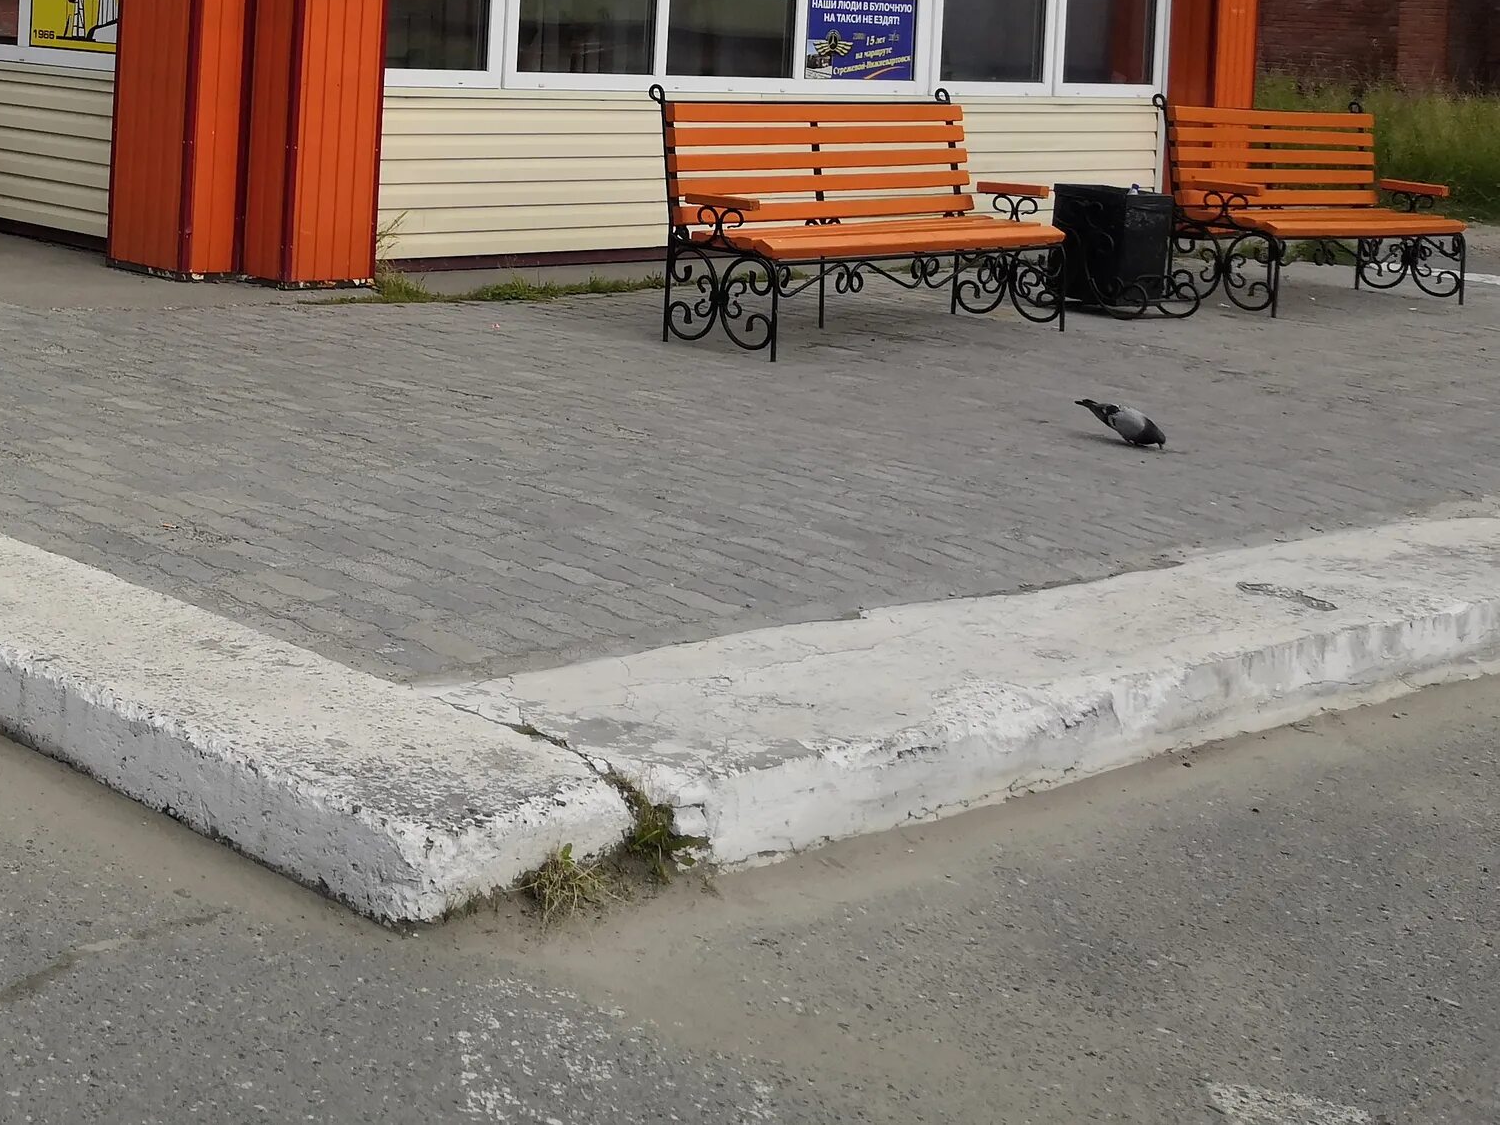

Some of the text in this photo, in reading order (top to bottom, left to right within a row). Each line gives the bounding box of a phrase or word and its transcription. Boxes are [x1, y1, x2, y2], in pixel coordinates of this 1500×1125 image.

[812, 0, 912, 13] НАШИ ЛЮДИ В БУЛОЧНУЮ
[824, 13, 900, 26] НА ТАКСИ НЕ ЕЗДЯТ!
[866, 36, 875, 46] 15
